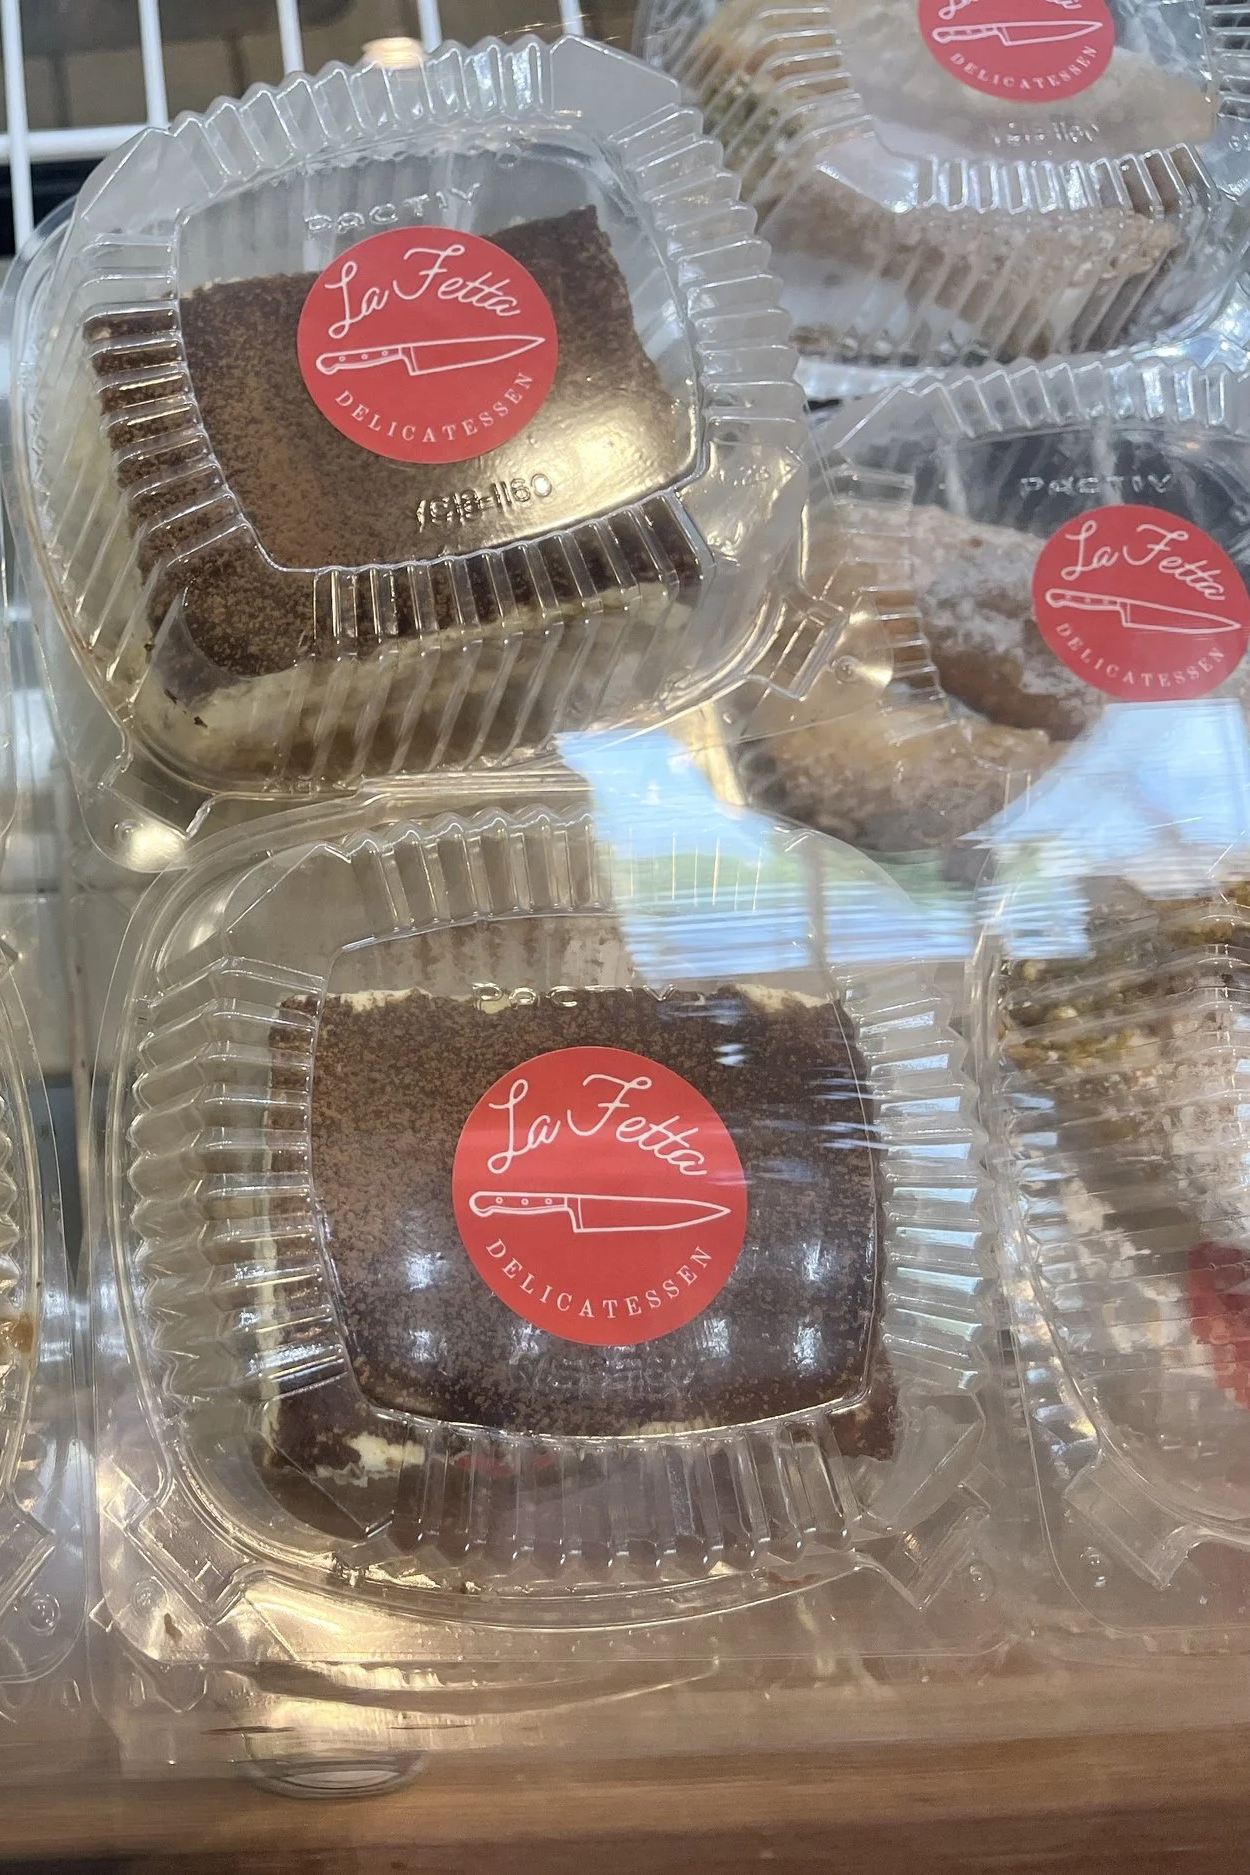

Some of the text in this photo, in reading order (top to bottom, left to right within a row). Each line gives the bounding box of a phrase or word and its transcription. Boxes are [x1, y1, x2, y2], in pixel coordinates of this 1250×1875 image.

[950, 45, 1098, 90] DELICATESSEN
[324, 244, 521, 339] La Fetta
[335, 371, 535, 443] DELICATESSEN
[1060, 519, 1226, 601] La Fetta
[1055, 622, 1225, 688] DELICATESSEN
[486, 1073, 709, 1177] La Fetta
[485, 1238, 713, 1319] DELICATESSEN
